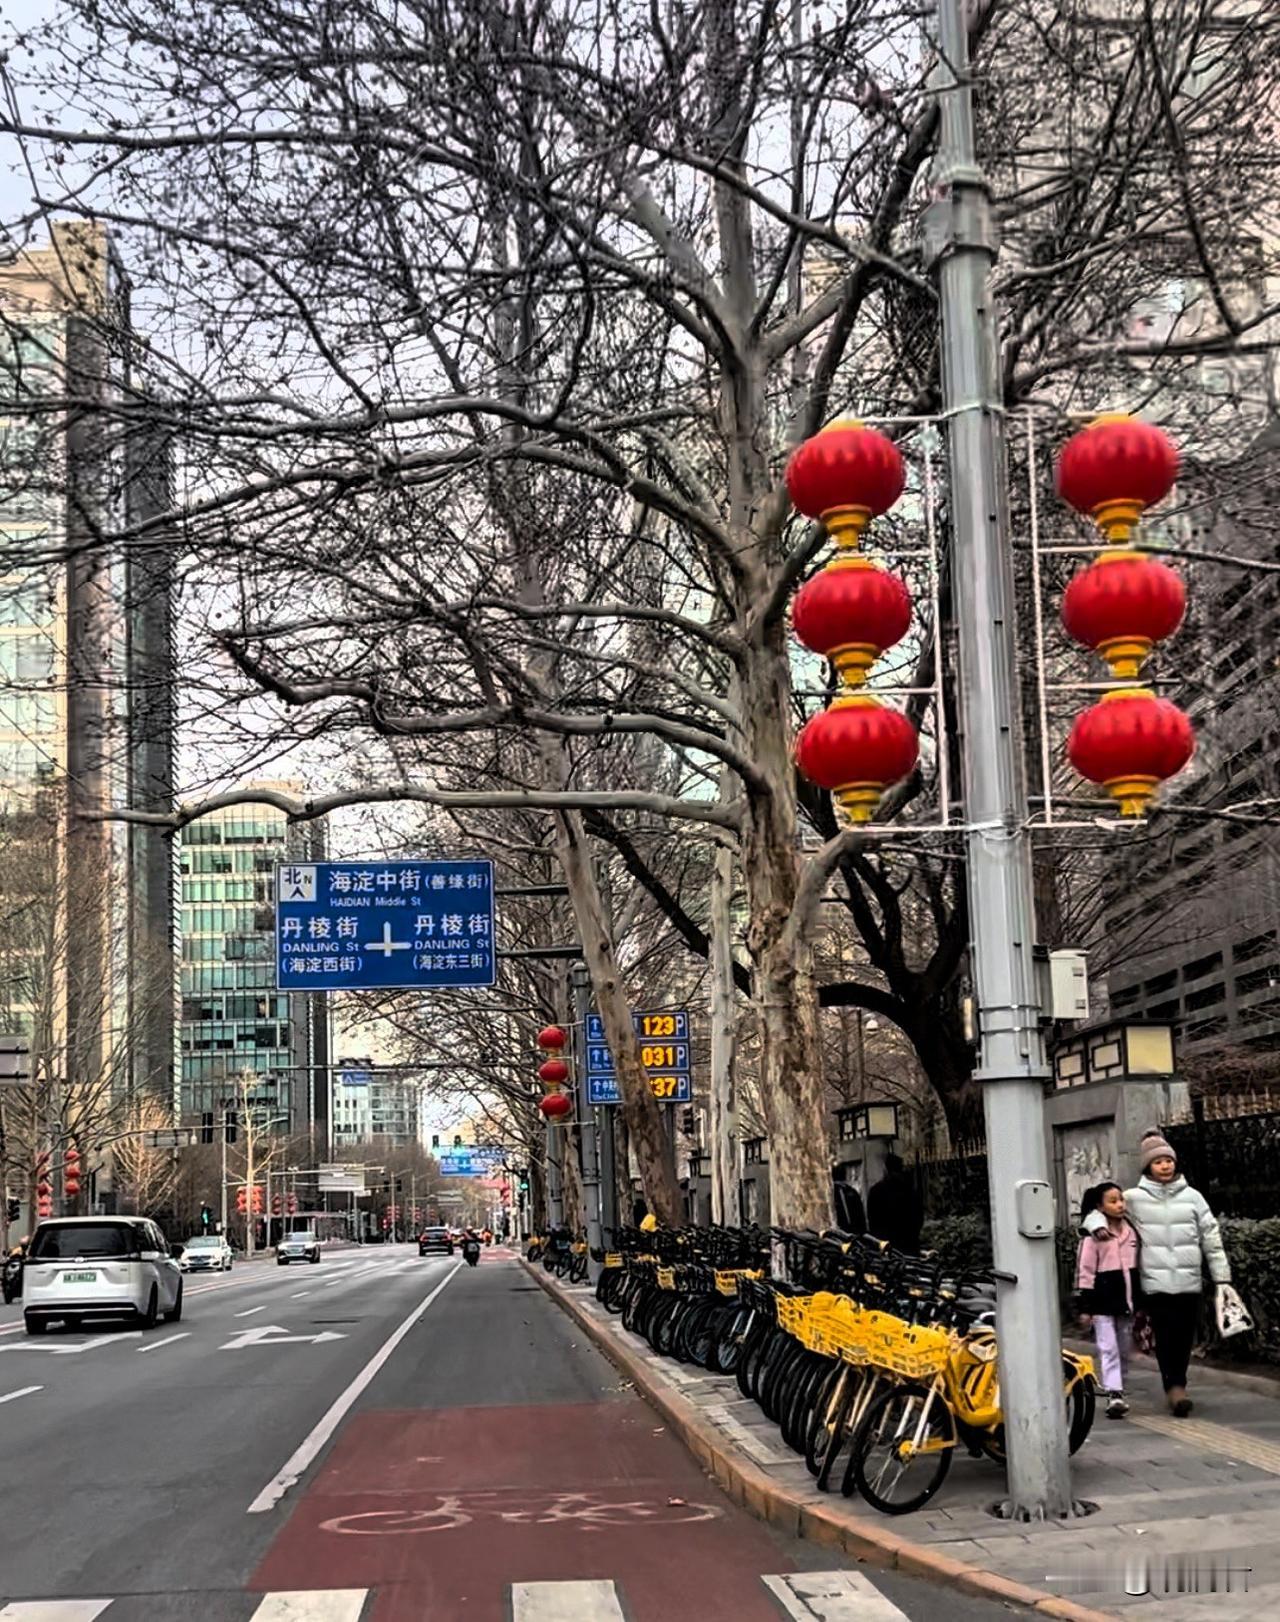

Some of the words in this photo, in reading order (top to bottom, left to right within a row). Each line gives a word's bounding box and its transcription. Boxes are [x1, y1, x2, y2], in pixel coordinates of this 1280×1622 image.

[284, 868, 302, 885] 北
[304, 875, 312, 884] N
[329, 869, 421, 892] 海淀中街
[330, 896, 371, 907] HAIDIAN
[375, 896, 406, 907] Middle
[411, 896, 421, 907] St
[281, 915, 359, 939] 丹棱街
[414, 913, 490, 936] 丹棱街
[283, 942, 340, 953] DANLING
[346, 941, 359, 952] St
[414, 939, 470, 951] DANLING
[476, 938, 489, 949] St
[643, 1015, 674, 1036] 123
[675, 1015, 684, 1036] P
[641, 1047, 674, 1067] 031
[676, 1046, 686, 1067] P
[649, 1077, 677, 1097] 37
[677, 1077, 686, 1098] P
